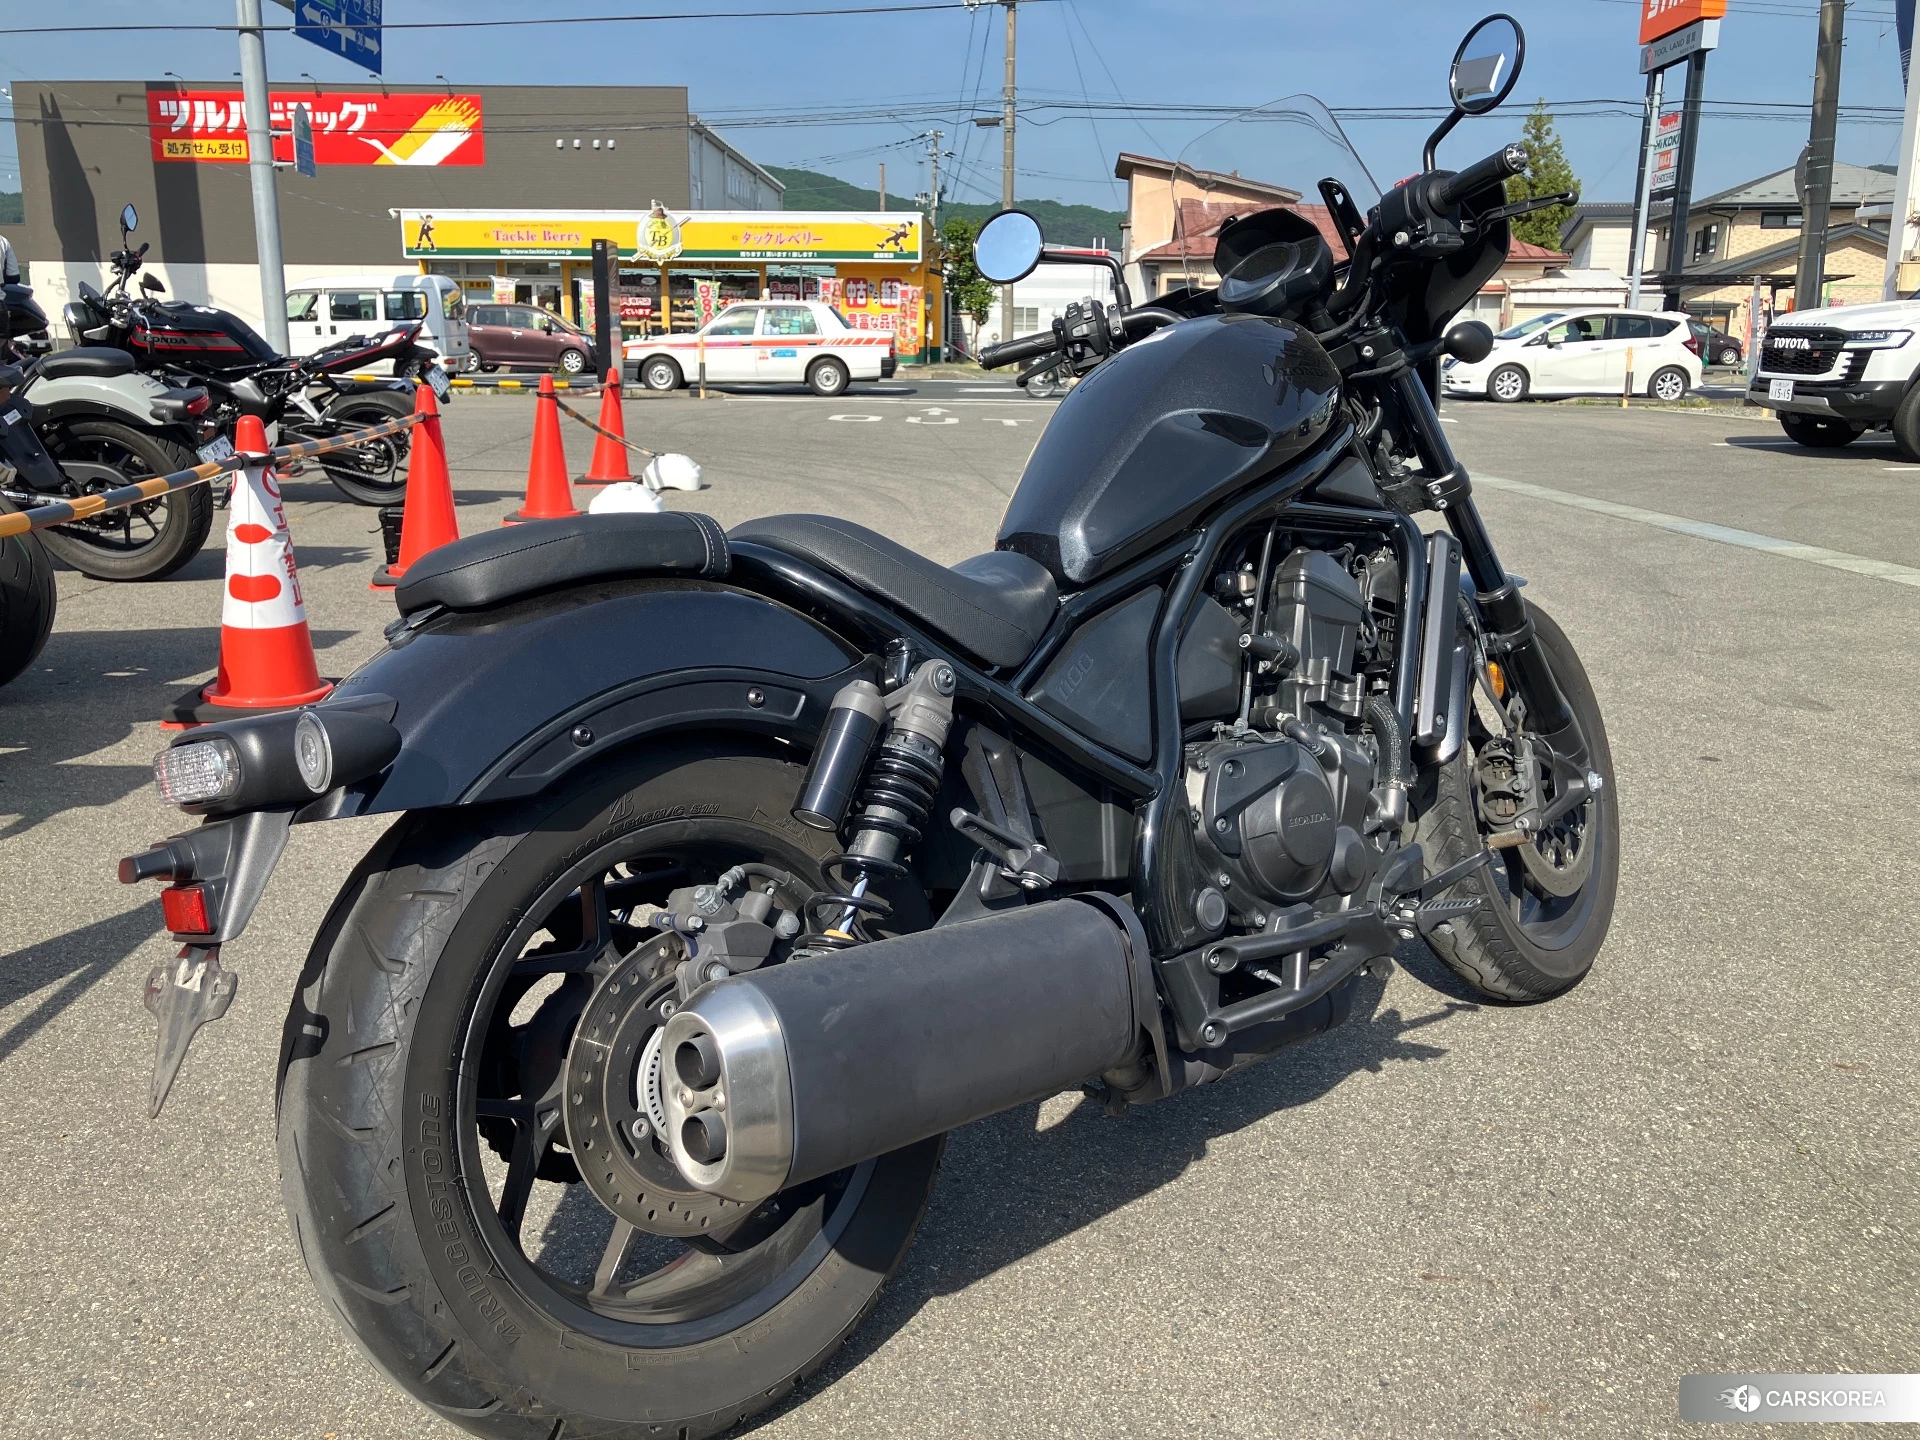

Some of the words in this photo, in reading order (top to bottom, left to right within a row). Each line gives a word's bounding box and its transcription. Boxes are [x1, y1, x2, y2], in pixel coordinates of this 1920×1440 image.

[1669, 38, 1685, 51] LAND
[167, 142, 242, 155] 処方せん受付
[493, 230, 538, 242] Tackle
[543, 230, 582, 245] Berry
[741, 231, 824, 247] タックルベリー
[846, 280, 867, 306] 中古
[1773, 337, 1811, 350] TOYOTA
[1288, 812, 1331, 828] HONDA
[420, 1092, 527, 1346] BRIDGESTONE
